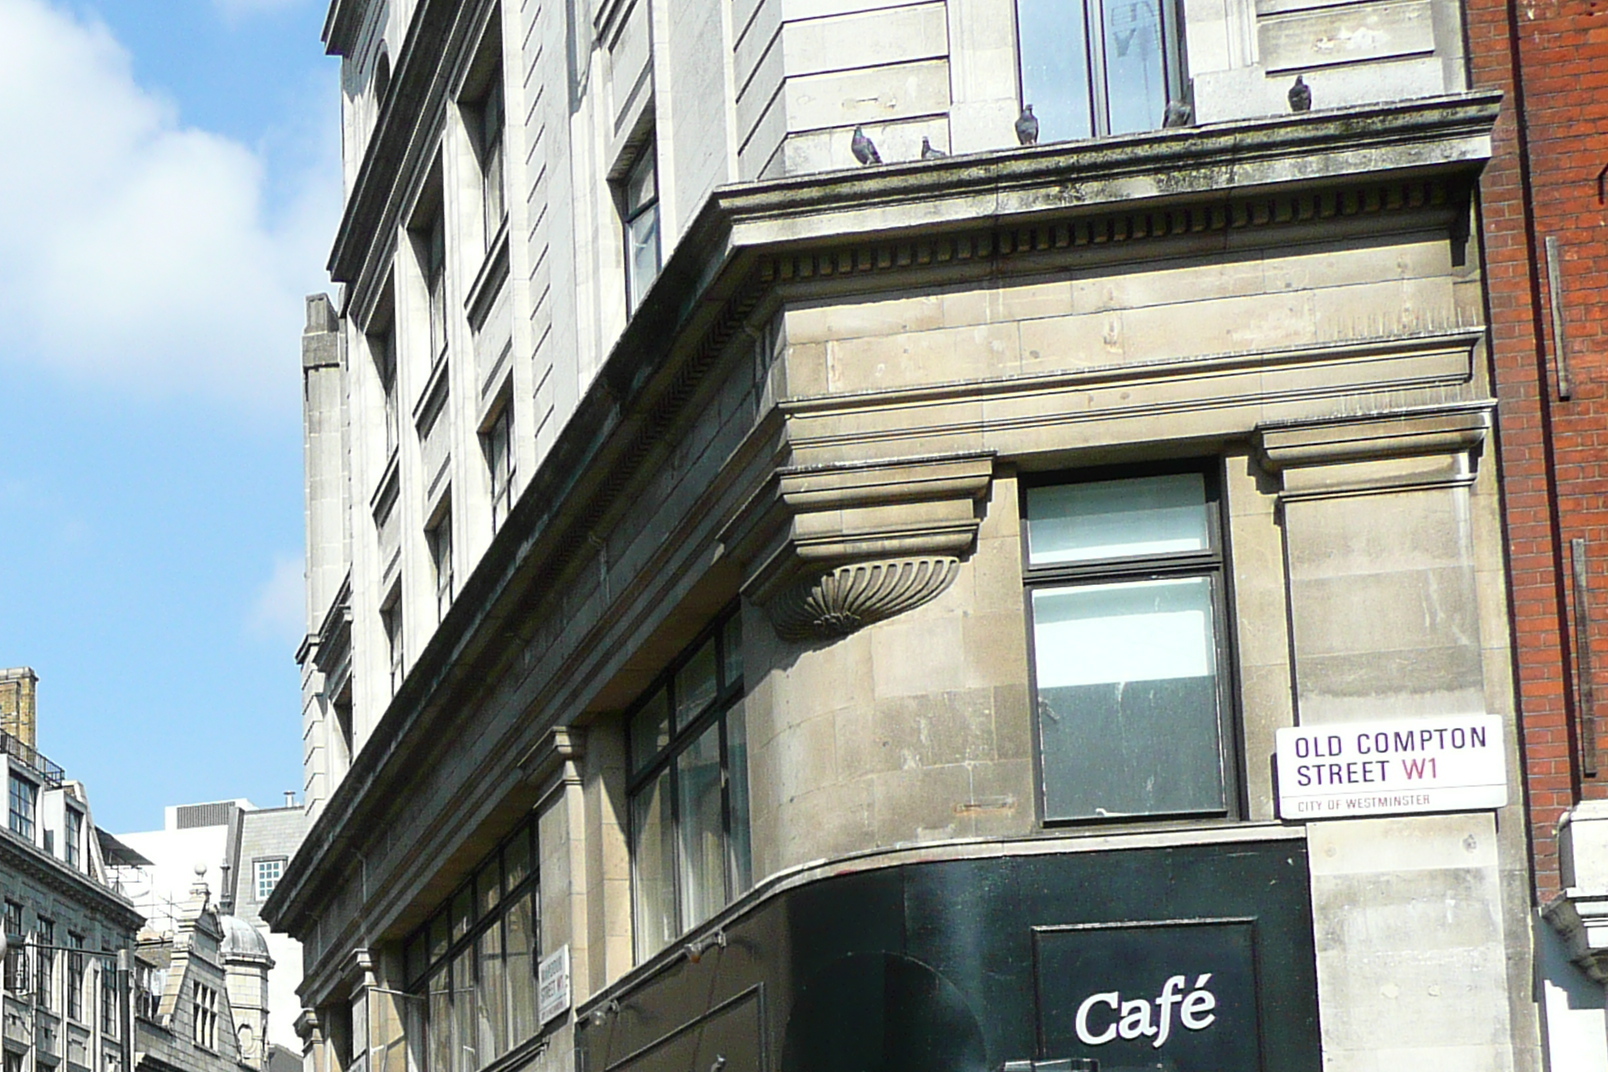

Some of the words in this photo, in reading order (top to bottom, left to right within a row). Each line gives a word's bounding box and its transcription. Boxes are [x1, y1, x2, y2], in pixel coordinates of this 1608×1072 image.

[1295, 735, 1342, 758] OLD
[1357, 726, 1486, 755] COMPTON
[1297, 760, 1390, 787] STREET
[1401, 757, 1437, 780] W1
[1297, 800, 1323, 813] CITY
[1327, 798, 1342, 811] OF
[1345, 794, 1431, 810] WESTMINSTER
[1075, 972, 1217, 1049] Café
